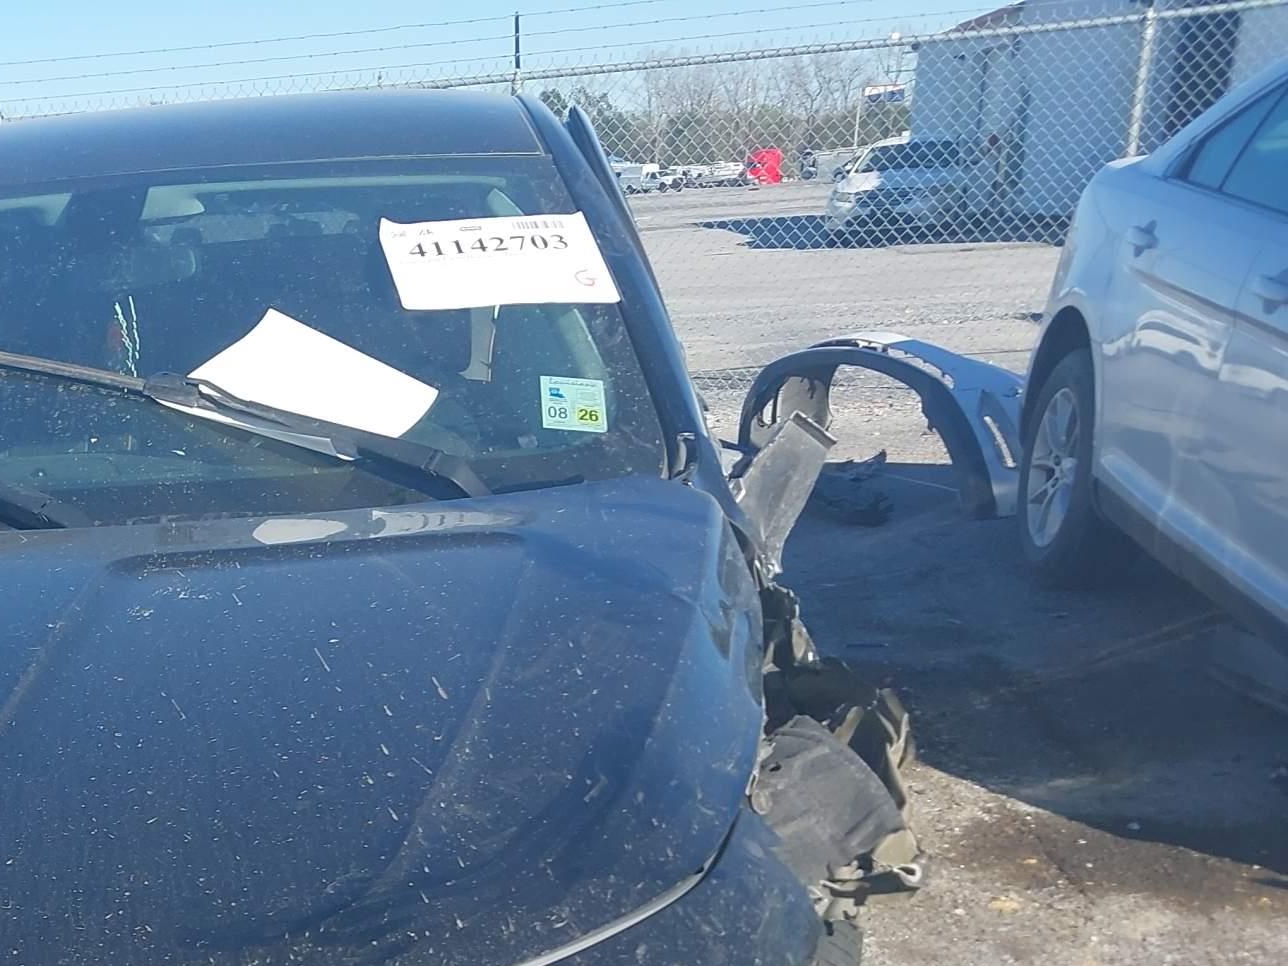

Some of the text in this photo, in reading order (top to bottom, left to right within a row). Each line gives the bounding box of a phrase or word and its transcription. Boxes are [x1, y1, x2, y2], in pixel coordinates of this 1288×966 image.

[408, 234, 569, 257] 41142703
[548, 407, 599, 422] 08 26
